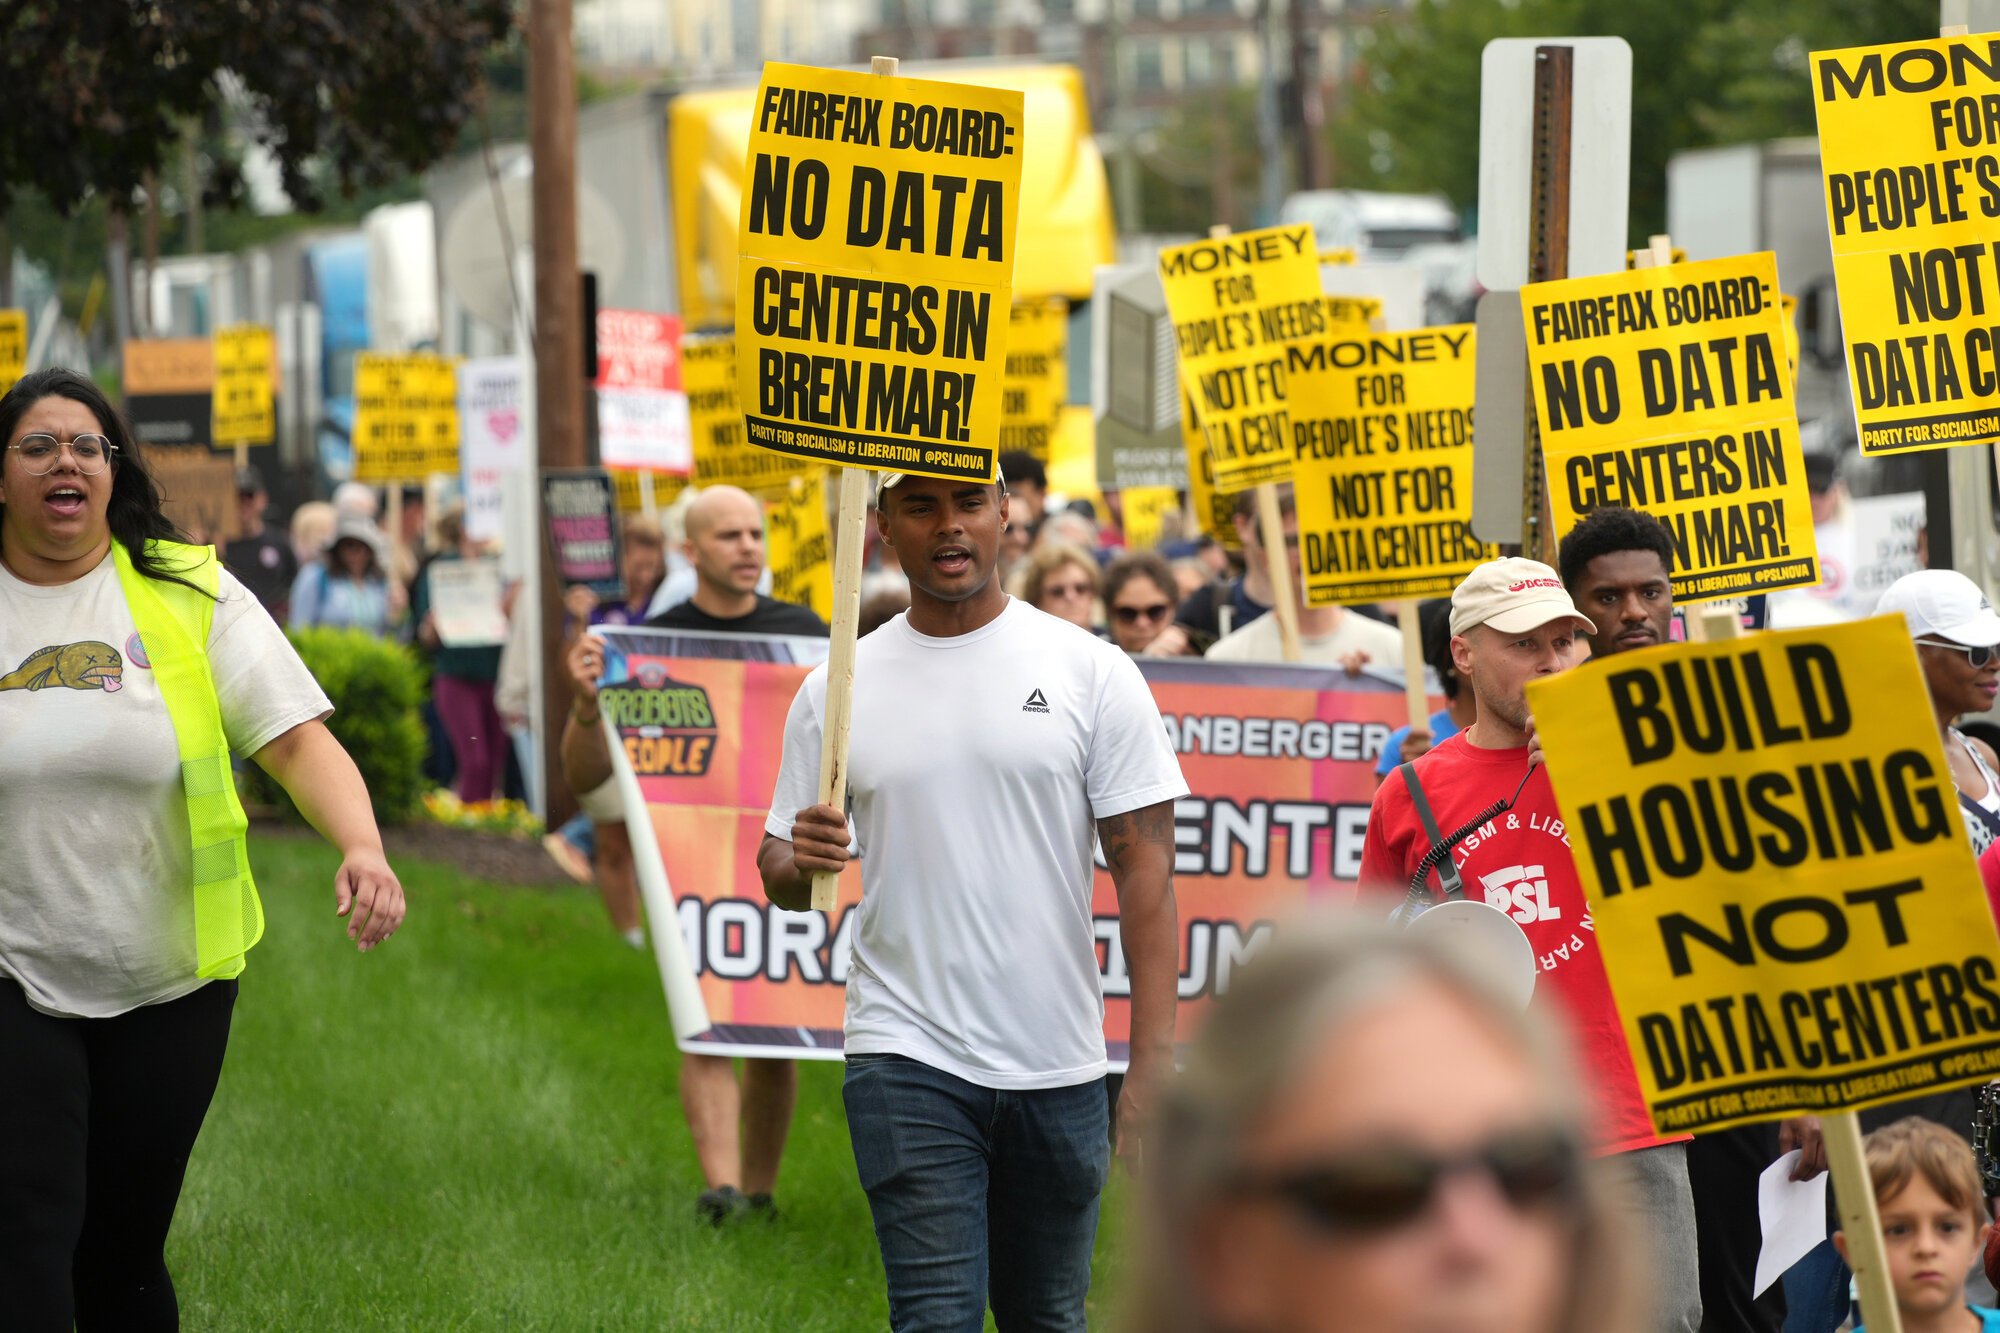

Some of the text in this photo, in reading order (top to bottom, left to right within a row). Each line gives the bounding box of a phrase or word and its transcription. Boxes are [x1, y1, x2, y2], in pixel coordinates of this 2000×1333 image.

[760, 86, 1014, 159] FAIRFAX BOARD:
[749, 153, 1002, 262] NO DATA
[1829, 155, 2000, 236] PEOPLE'S
[1160, 229, 1307, 277] MONEY
[1213, 275, 1256, 307] FOR
[1533, 275, 1771, 345] FAIRFAX BOARD:
[1889, 243, 1985, 325] NOT
[753, 267, 990, 361] CENTERS IN
[1259, 298, 1325, 343] NEEDS
[1286, 331, 1469, 373] MONEY
[1852, 333, 1964, 410] DATA
[760, 348, 975, 442] BREN MAR!
[1199, 359, 1287, 413] NOT FO
[1356, 374, 1405, 408] FOR
[1542, 332, 1782, 431] NO DATA
[751, 423, 984, 471] PARTY FOR SOCIALISM & LIBERATION @PSLNOVA
[1294, 414, 1400, 460] PEOPLE'S
[1864, 416, 2000, 447] PARTY FOR SOCIALISM
[1330, 471, 1385, 520] NOT
[1394, 465, 1456, 515] FOR
[1566, 428, 1787, 515] CENTERS IN
[1306, 526, 1370, 575] DATA
[1693, 498, 1790, 568] MAR!
[1525, 579, 1543, 588] DC
[1688, 580, 1696, 594] &
[1698, 573, 1752, 593] LIBERATION
[1755, 563, 1810, 583] @PSLNOVA
[1022, 705, 1051, 714] Reebok
[1607, 642, 1852, 767] BUILD
[622, 736, 711, 774] EOPLE
[1506, 813, 1521, 830] &
[1530, 812, 1575, 852] LIBE
[1578, 748, 1953, 898] HOUSING
[1484, 880, 1561, 924] PSL
[1656, 877, 1924, 978] NOT
[1535, 934, 1585, 973] PAR
[1637, 956, 2000, 1092] DATA CENTERS
[1654, 1102, 1710, 1129] PARTY
[1709, 1095, 1744, 1118] FOR
[1743, 1086, 1825, 1112] SOCIALISM
[1840, 1061, 1936, 1101] LIBERATION
